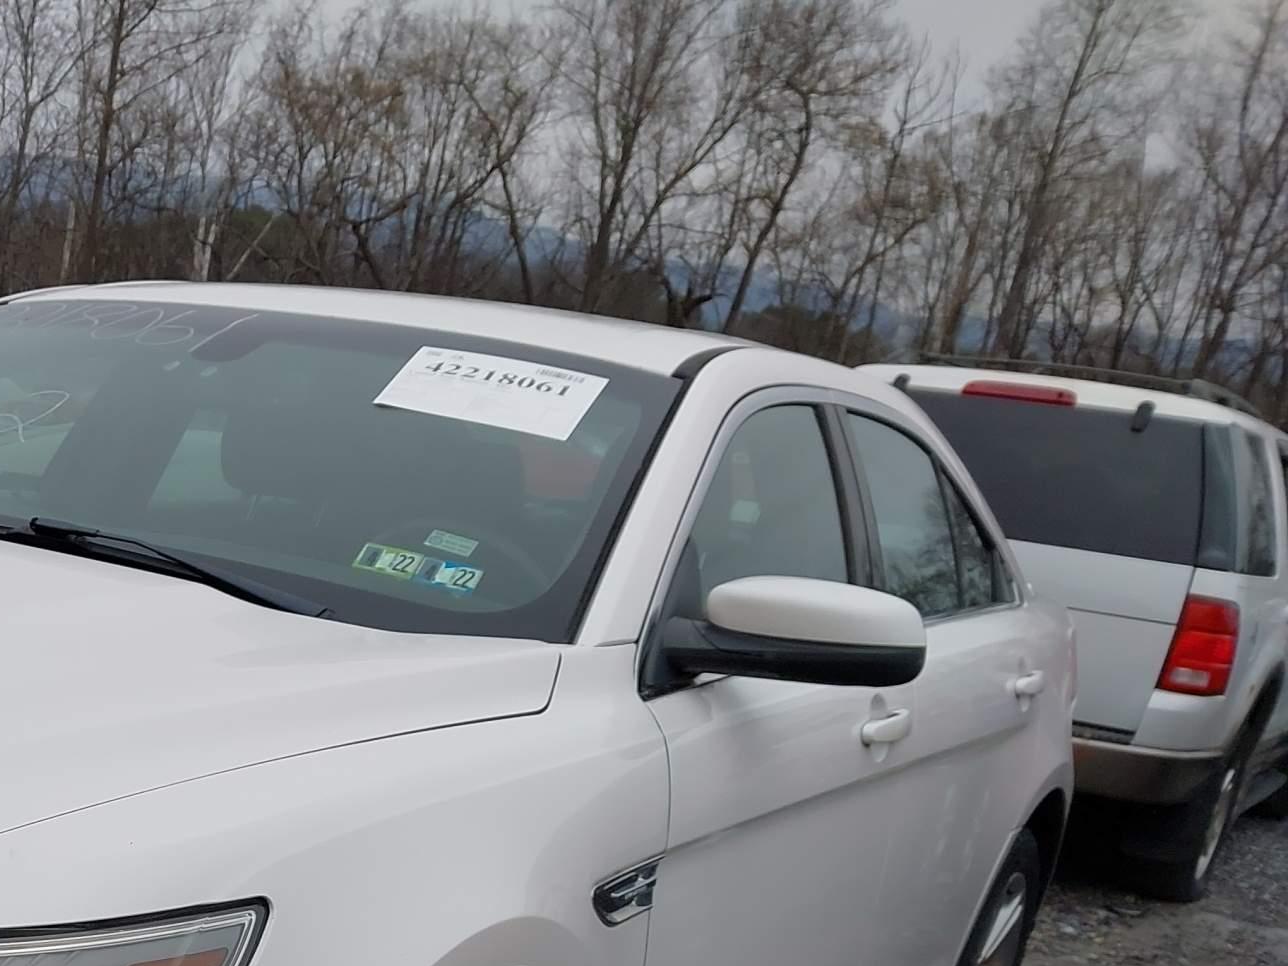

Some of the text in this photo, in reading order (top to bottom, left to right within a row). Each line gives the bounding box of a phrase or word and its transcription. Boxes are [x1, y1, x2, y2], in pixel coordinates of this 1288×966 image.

[425, 361, 570, 396] 42218061
[392, 554, 415, 573] 22
[453, 569, 476, 588] 22
